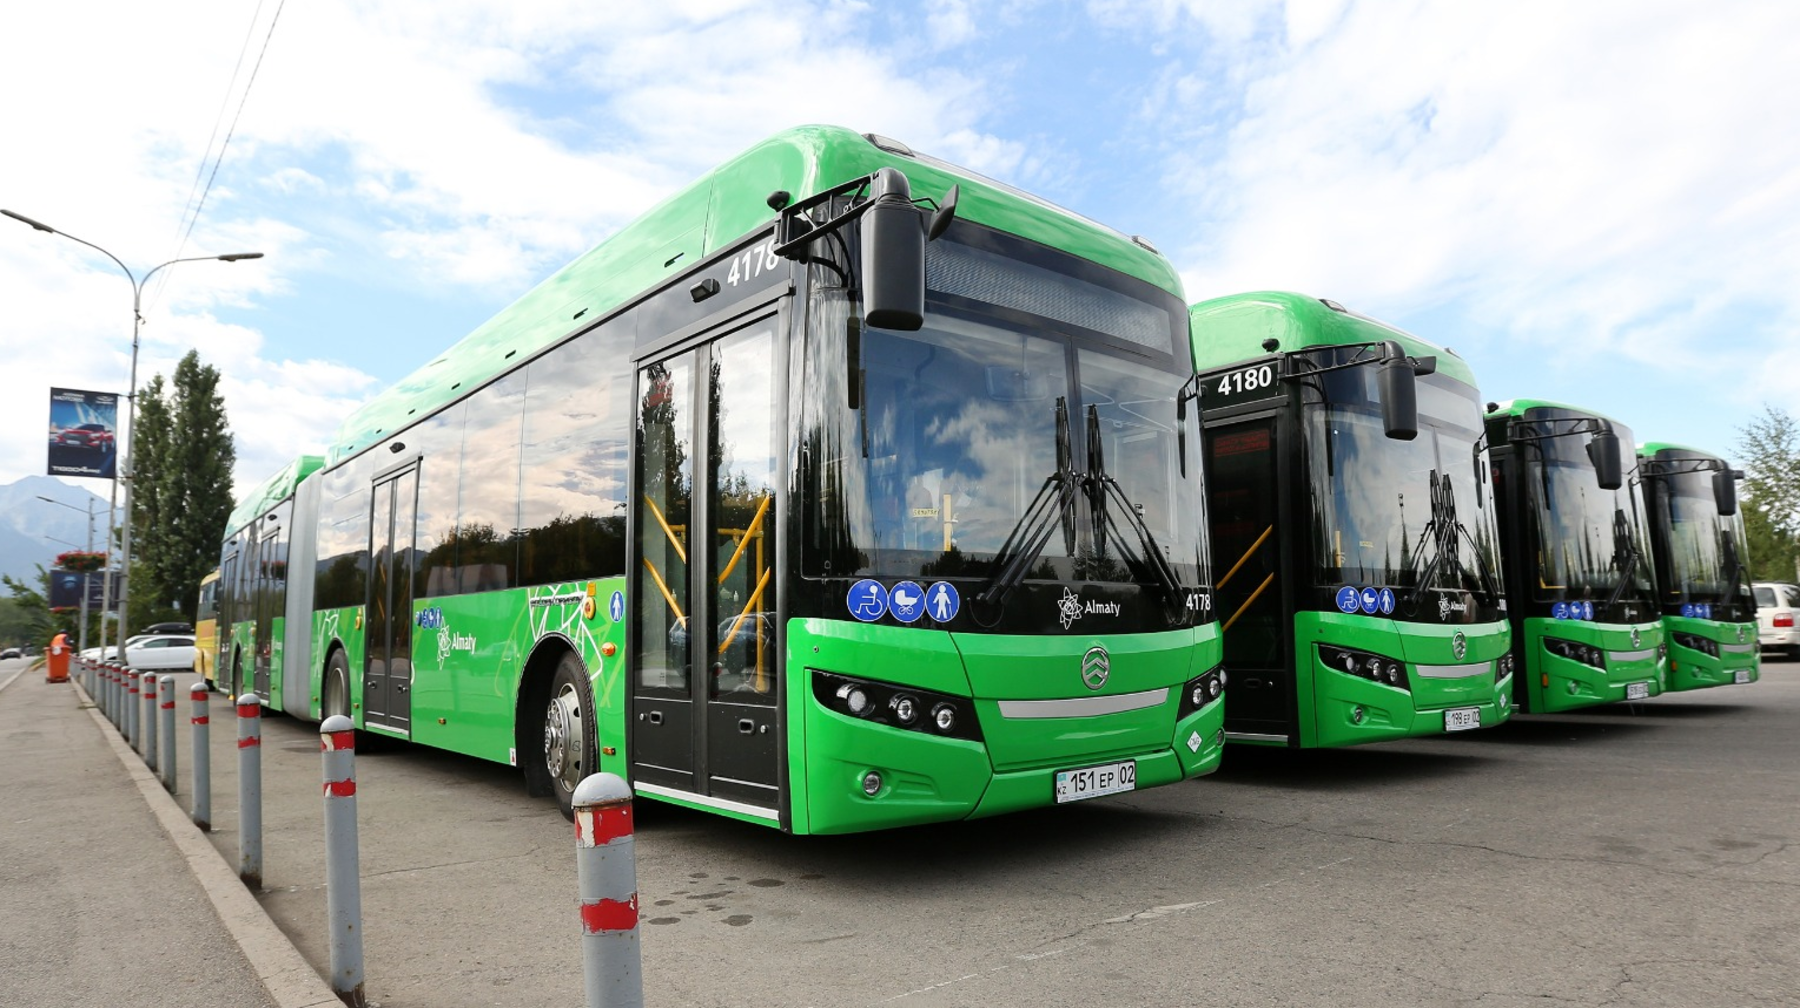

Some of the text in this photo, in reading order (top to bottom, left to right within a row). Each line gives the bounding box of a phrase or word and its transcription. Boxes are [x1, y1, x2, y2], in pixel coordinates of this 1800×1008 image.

[727, 238, 779, 287] 4178
[1217, 366, 1272, 396] 4180
[1084, 599, 1121, 617] Almaty
[1186, 593, 1210, 612] 4178
[451, 631, 477, 655] Almaty
[1070, 764, 1135, 793] 151 EP 02
[1057, 786, 1067, 796] KZ
